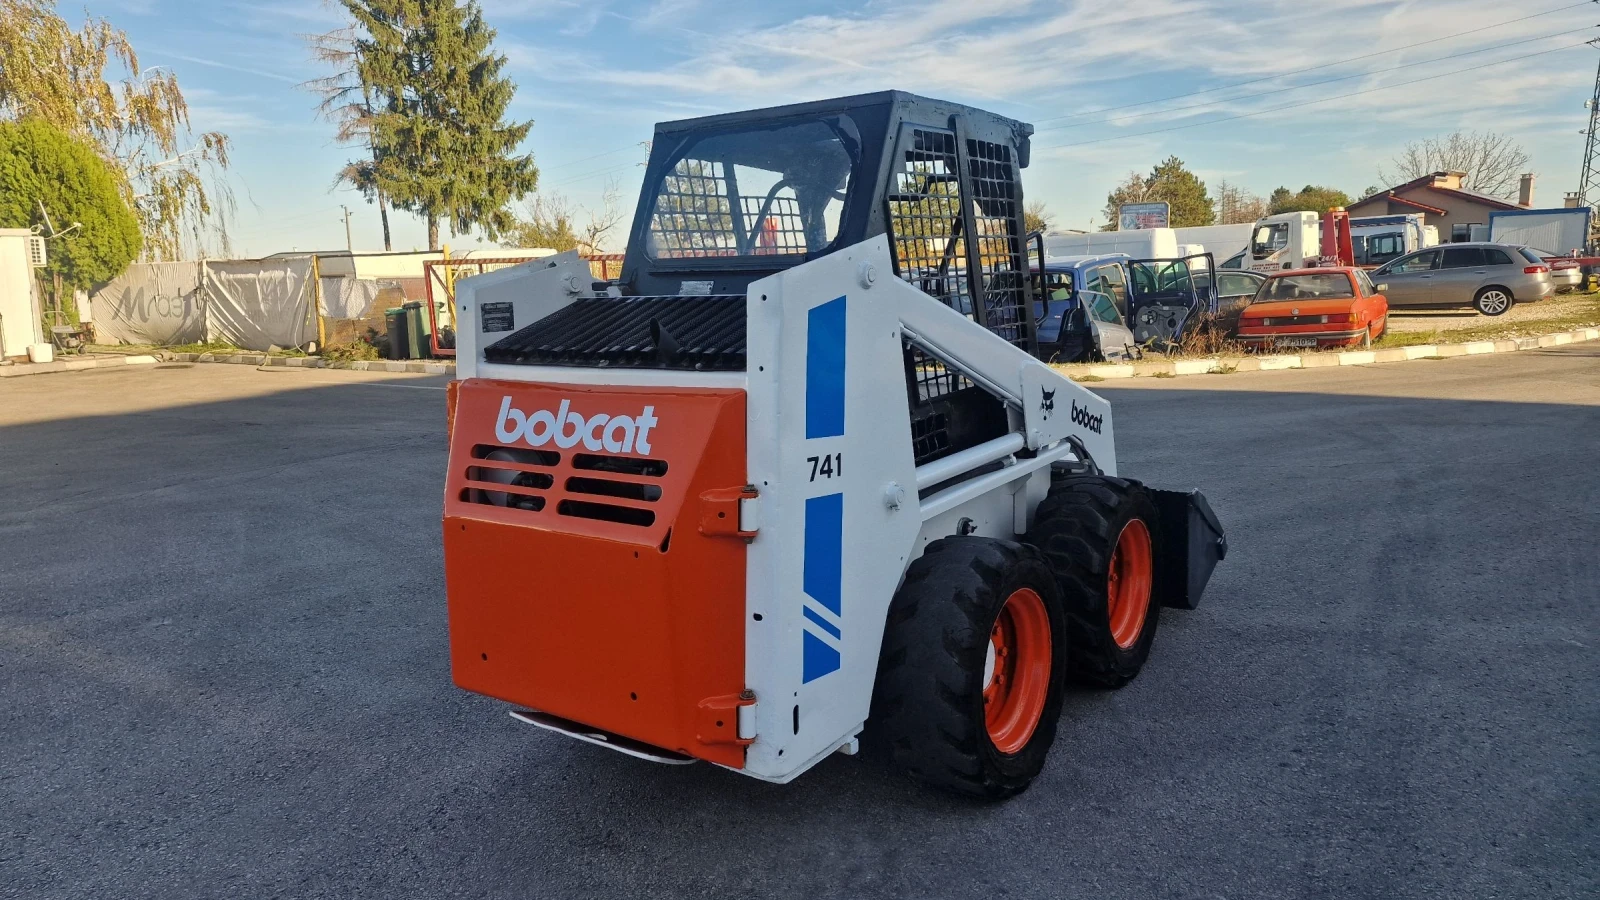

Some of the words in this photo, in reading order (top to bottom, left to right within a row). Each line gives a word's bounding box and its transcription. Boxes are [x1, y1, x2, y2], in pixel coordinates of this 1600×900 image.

[495, 396, 658, 455] bobcat
[1071, 399, 1103, 435] bobcat
[807, 453, 841, 482] 741
